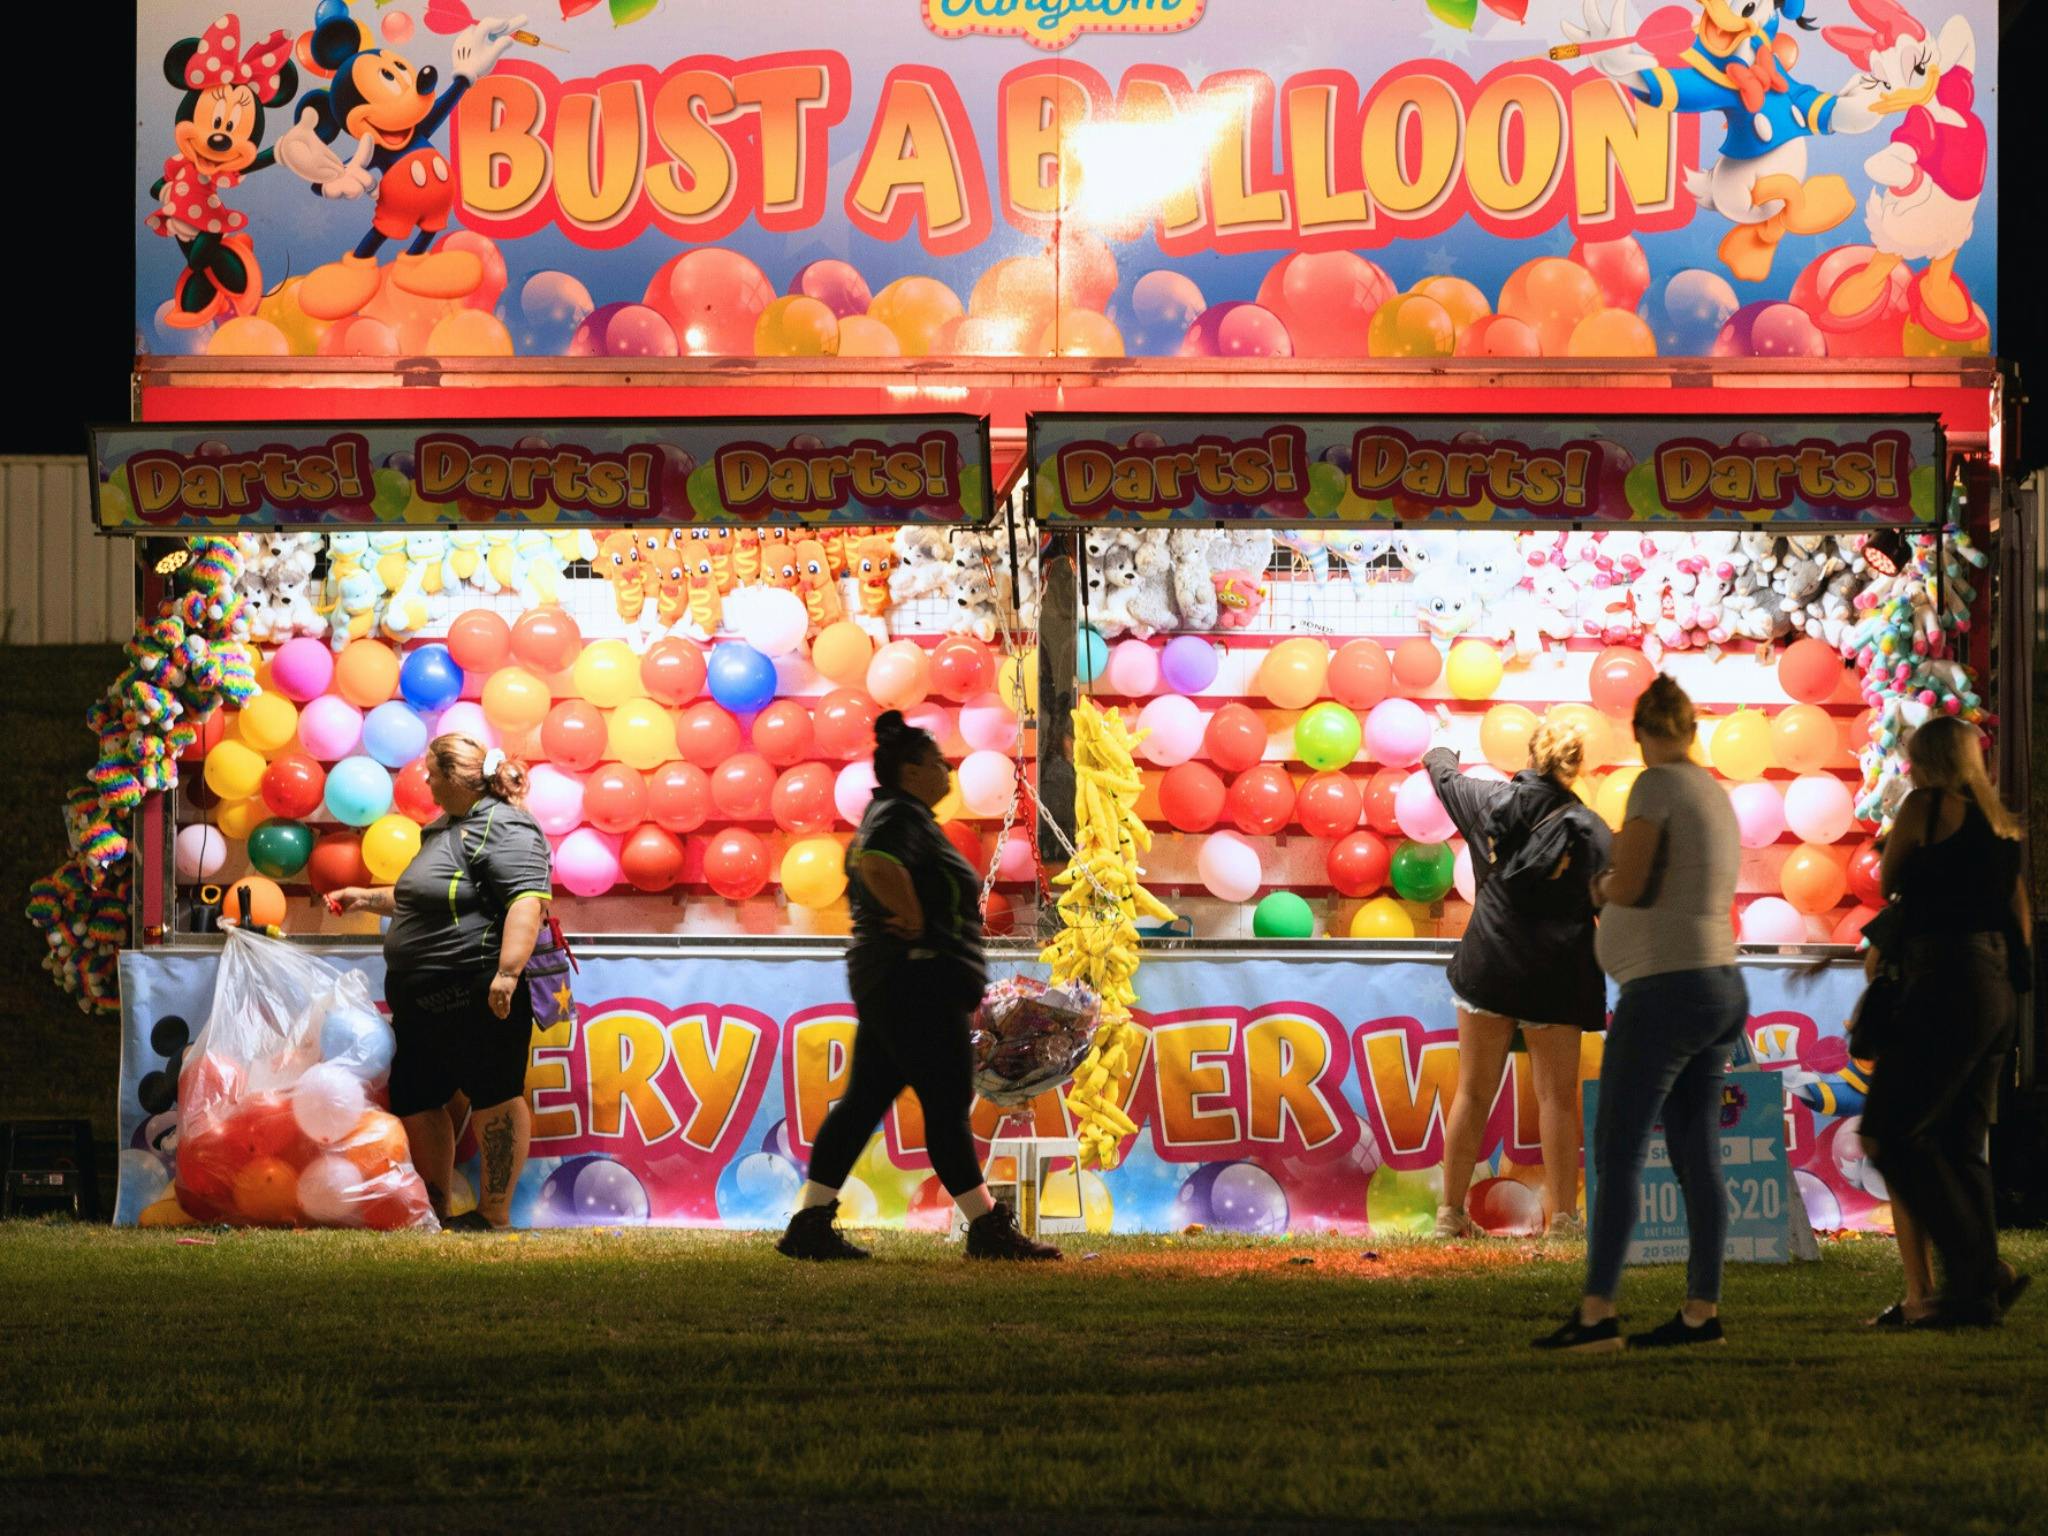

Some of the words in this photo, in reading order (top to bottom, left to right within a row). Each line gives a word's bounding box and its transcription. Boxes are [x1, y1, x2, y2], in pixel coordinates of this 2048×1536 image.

[459, 64, 830, 226] BUST
[852, 78, 971, 239] A
[133, 441, 364, 513] Darts!
[421, 441, 653, 509] Darts!
[721, 440, 949, 504] Darts!
[1064, 434, 1298, 506] Darts!
[1358, 435, 1591, 507] Darts!
[1661, 439, 1899, 503] Darts!
[526, 1009, 763, 1153] ERY
[1726, 1175, 1781, 1226] $20
[1662, 1243, 1690, 1257] SHO
